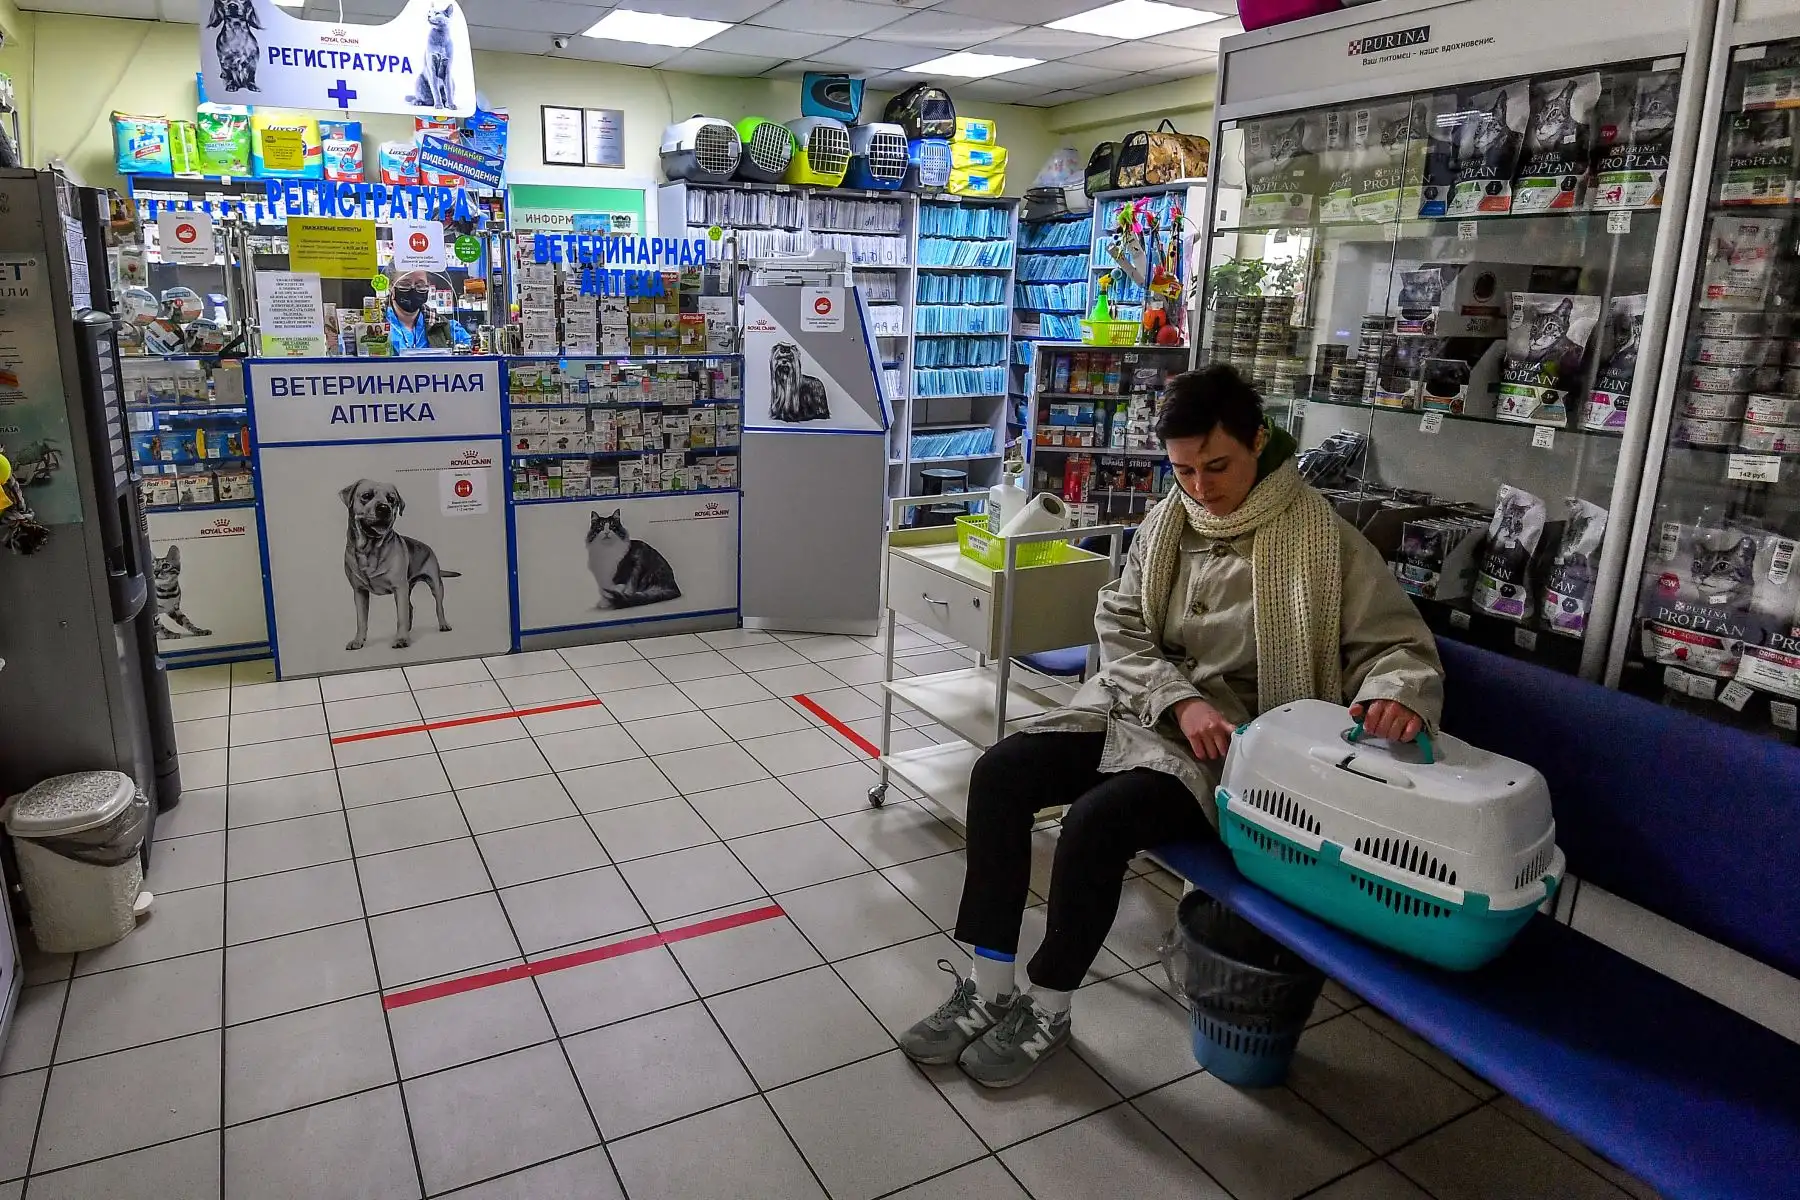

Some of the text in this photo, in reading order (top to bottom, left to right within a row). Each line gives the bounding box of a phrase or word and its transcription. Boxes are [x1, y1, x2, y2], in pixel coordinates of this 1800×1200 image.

[320, 36, 359, 45] ROYAL CANIN
[1362, 57, 1378, 66] Ваш
[1379, 52, 1411, 64] питомец
[1419, 46, 1440, 56] наше
[1441, 36, 1496, 52] вдохновение.
[1364, 30, 1427, 51] PURINA
[267, 46, 413, 74] РЕГИСТРАТУРА
[442, 143, 485, 163] ВНИМАНИЕ!
[421, 151, 500, 185] ВИДЕОНАБЛЮДЕНИЕ
[265, 179, 470, 221] РЕГИСТРАТУРА
[525, 213, 574, 225] ИНФОРМ
[534, 234, 707, 266] ВЕТЕРИНАРНАЯ
[579, 268, 666, 298] АПТЕКА
[270, 373, 485, 397] ВЕТЕРИНАРНАЯ
[330, 402, 435, 425] АПТЕКА
[222, 526, 245, 534] CANIN
[1657, 606, 1746, 637] PRO PLAN
[1686, 604, 1727, 620] PURINA
[1758, 649, 1794, 666] ORIGINAL
